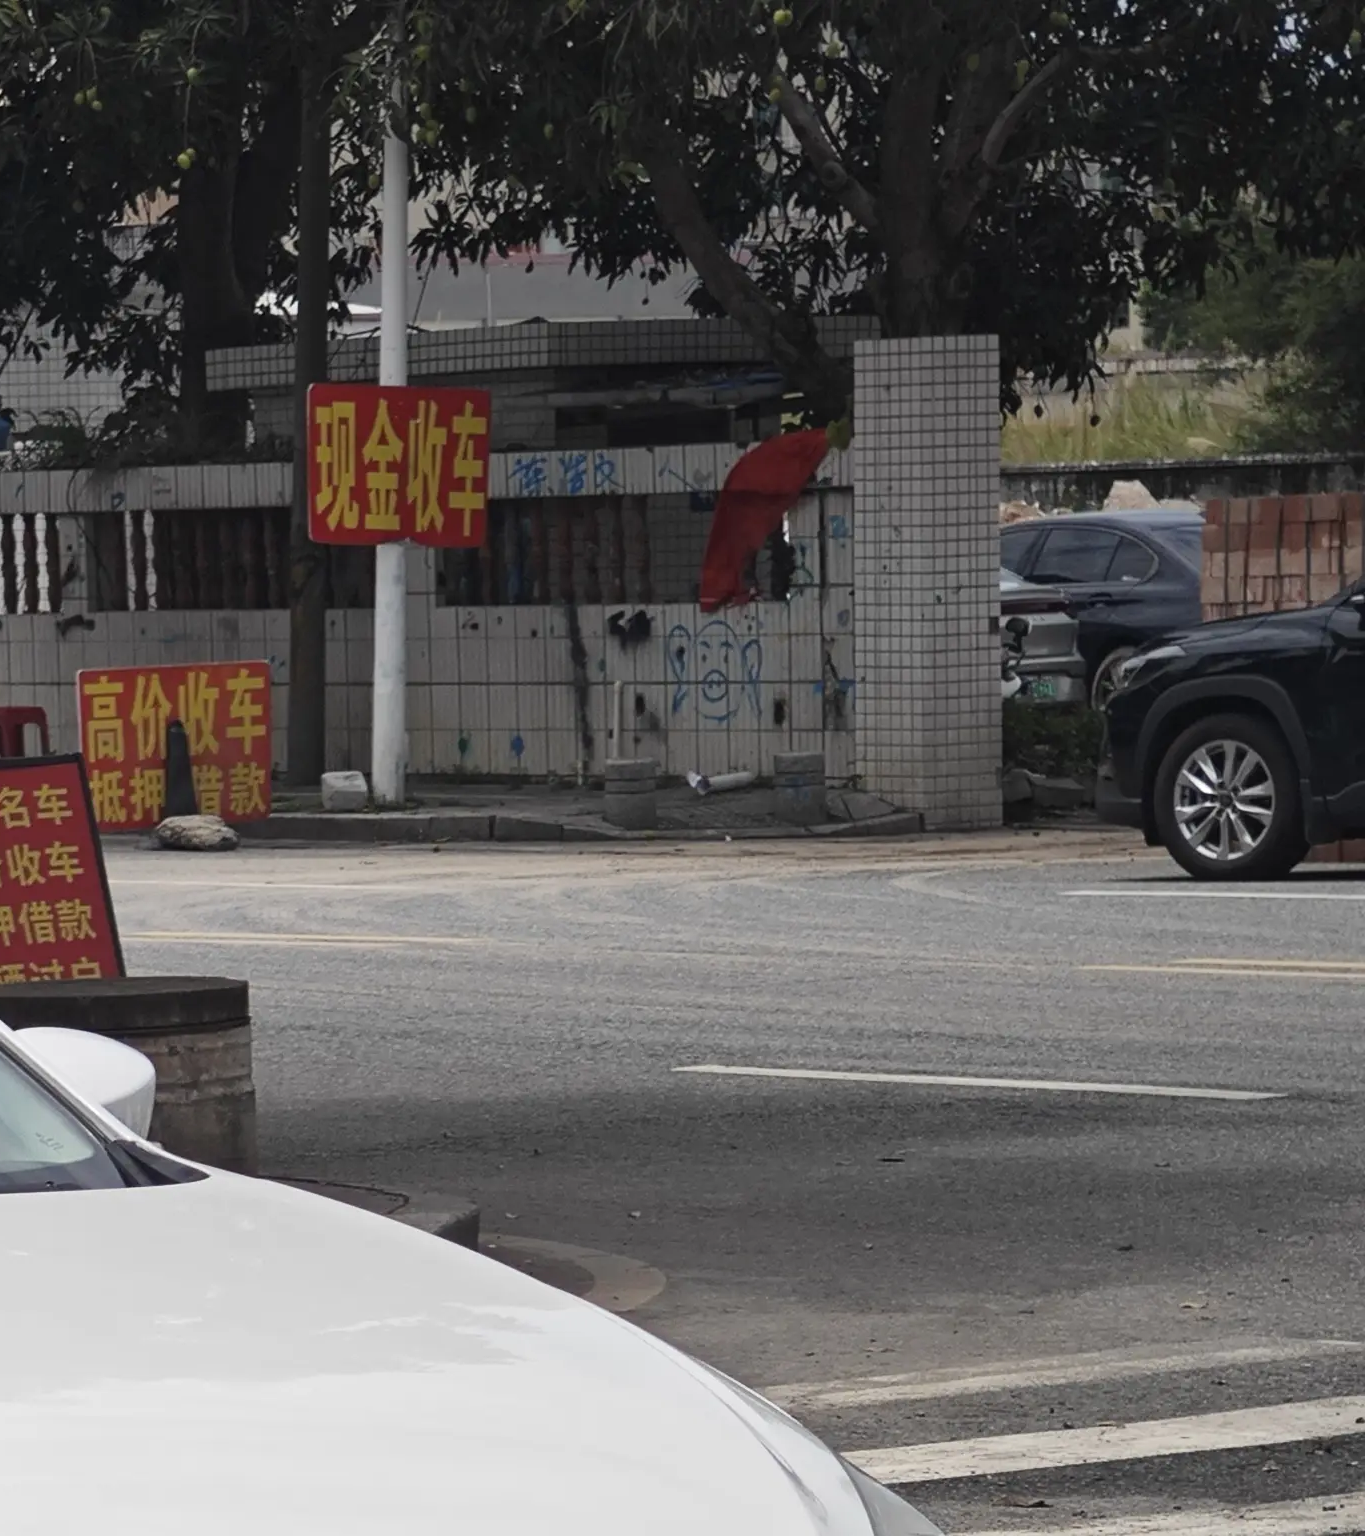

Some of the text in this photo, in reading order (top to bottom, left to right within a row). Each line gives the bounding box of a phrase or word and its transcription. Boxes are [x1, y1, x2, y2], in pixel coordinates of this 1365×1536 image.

[316, 397, 487, 537] 现金收车
[83, 668, 267, 763] 高价收车
